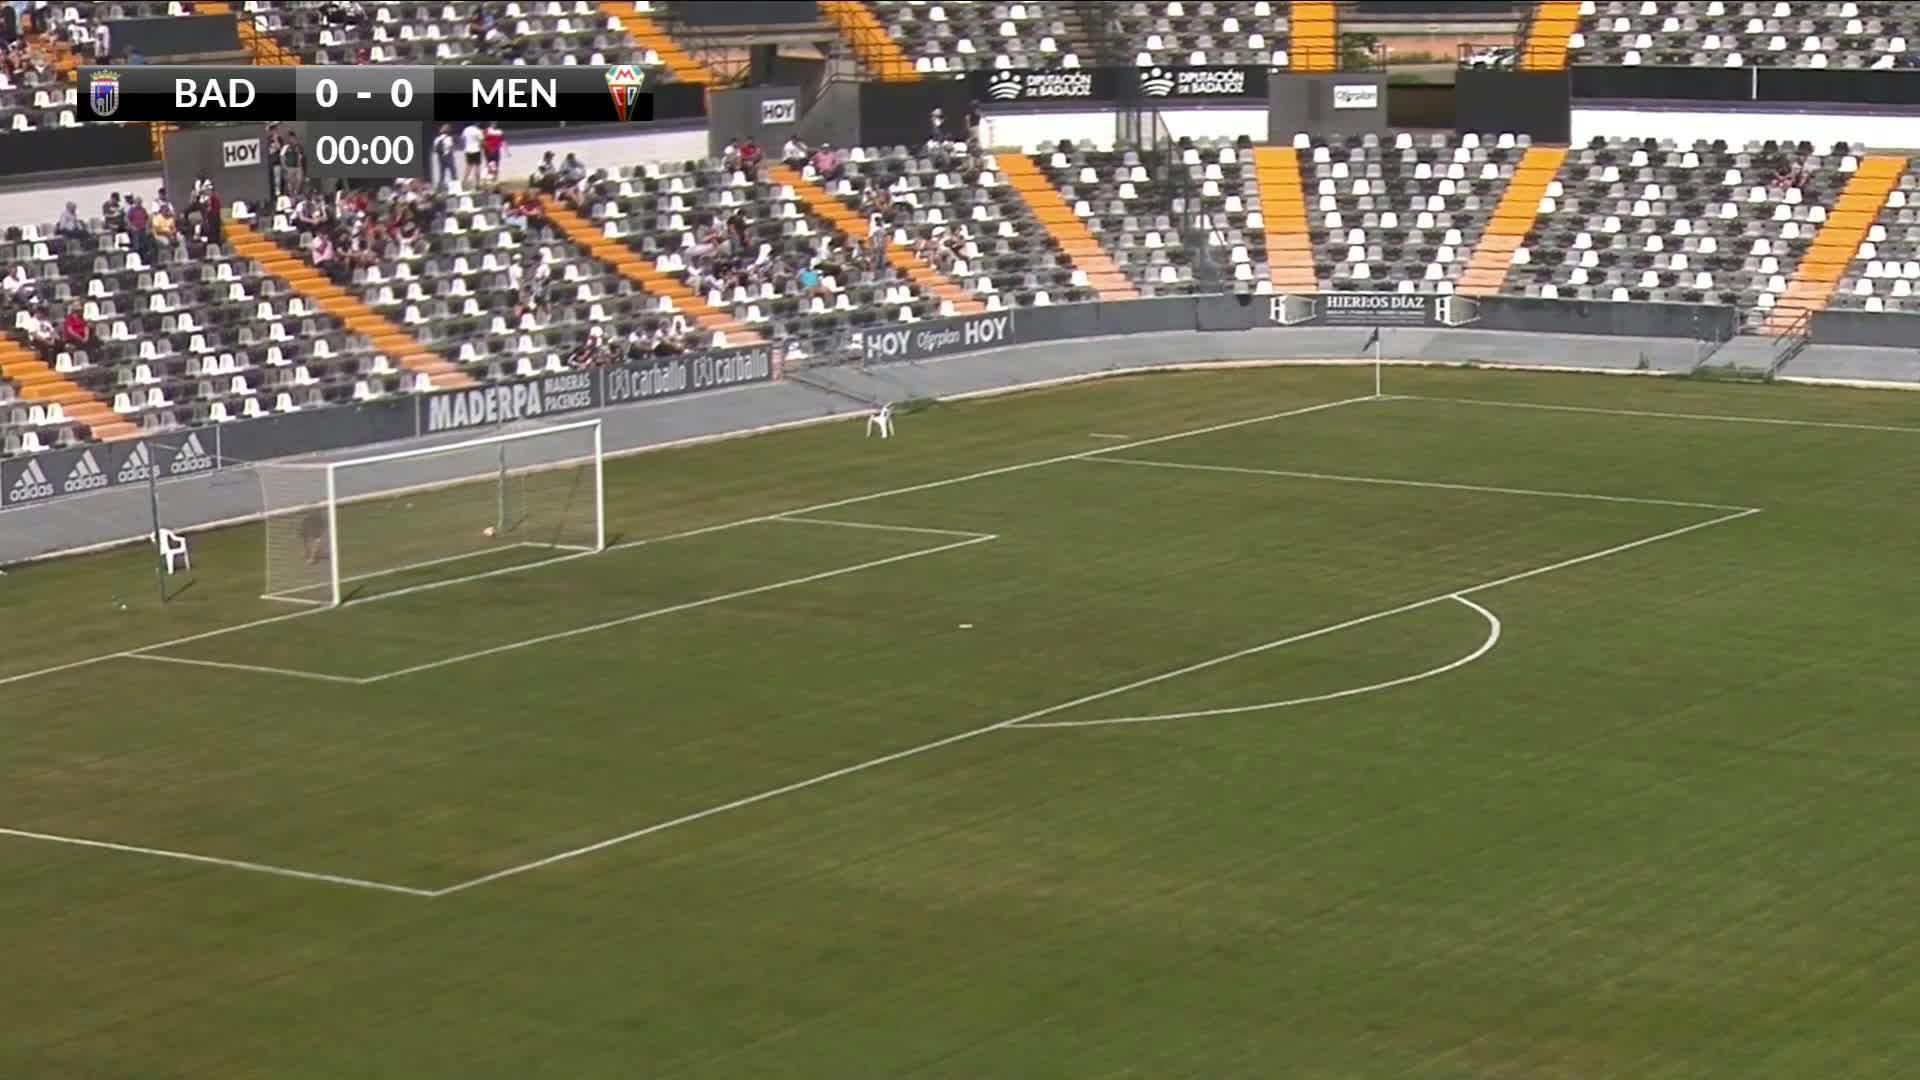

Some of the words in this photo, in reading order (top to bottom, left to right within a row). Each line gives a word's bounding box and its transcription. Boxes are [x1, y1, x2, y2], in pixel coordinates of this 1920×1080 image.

[1026, 71, 1092, 86] DIPUTACIÓN
[1178, 69, 1244, 83] DIPUTACIÓN
[1040, 84, 1092, 96] BADAJOZ
[1191, 81, 1244, 93] BADAJOZ
[763, 104, 794, 119] HOY
[224, 140, 259, 165] HOY
[1391, 295, 1425, 308] DÍAZ
[867, 329, 911, 359] HOY
[964, 316, 1008, 345] HOY
[715, 348, 769, 384] carballo
[544, 372, 591, 393] MADERAS
[631, 359, 687, 397] carballo
[428, 380, 542, 432] MADERPA
[544, 390, 592, 412] PACENSES
[170, 455, 213, 473] adidas
[10, 482, 55, 502] adidas
[64, 473, 109, 492] adidas
